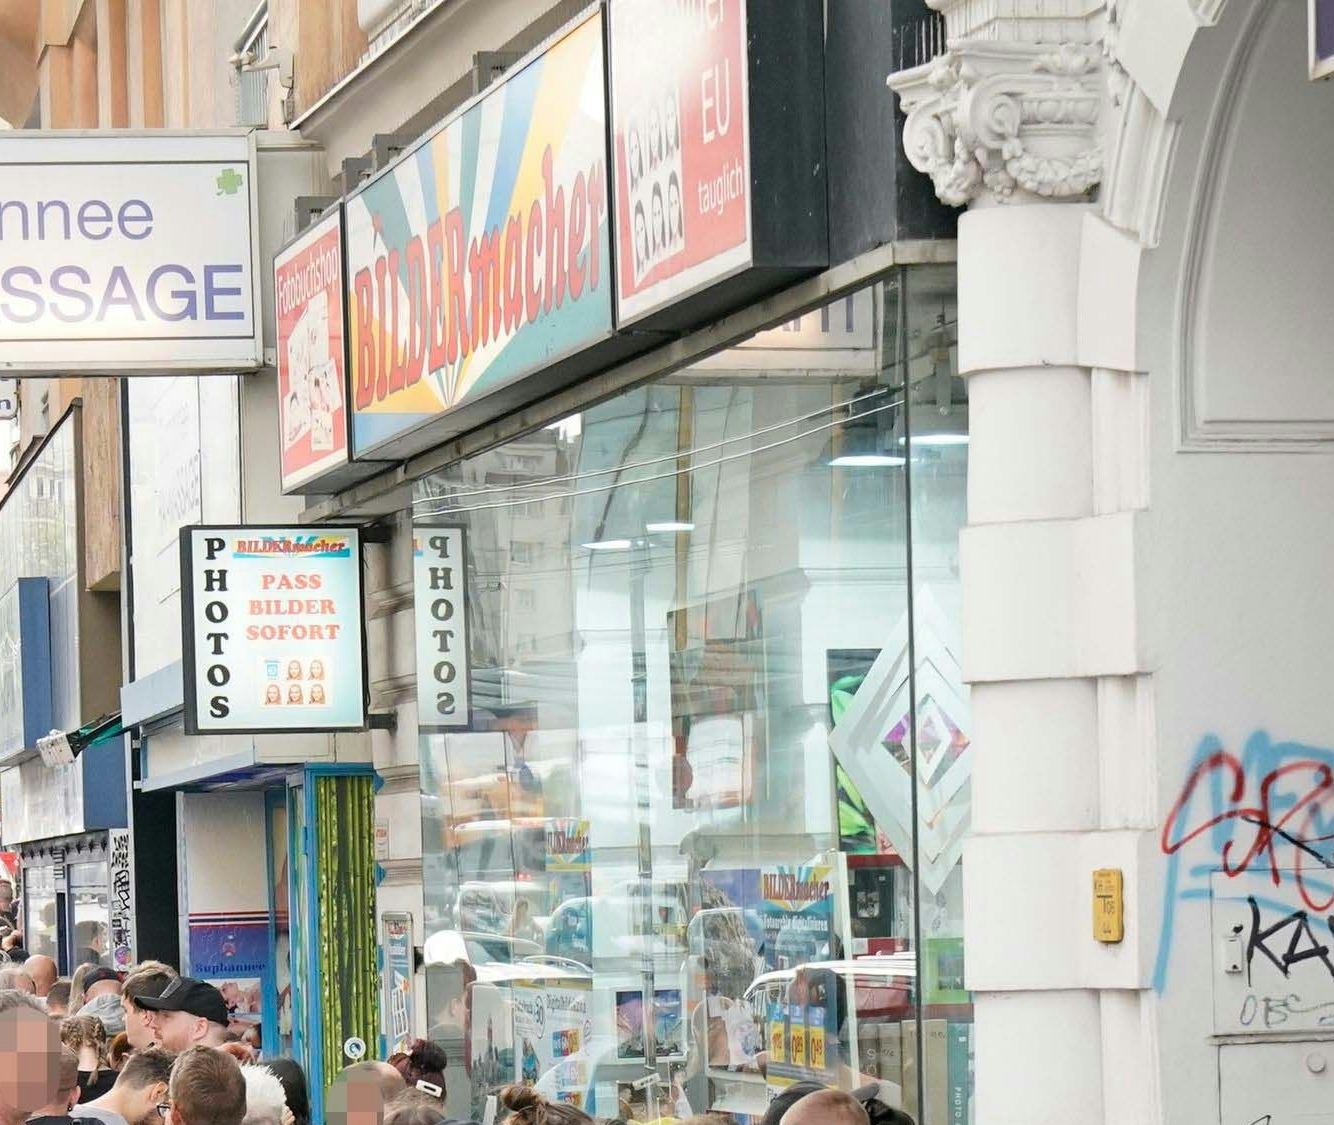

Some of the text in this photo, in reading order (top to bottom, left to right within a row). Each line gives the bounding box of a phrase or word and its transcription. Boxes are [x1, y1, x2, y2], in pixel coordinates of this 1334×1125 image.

[701, 58, 731, 144] EU
[698, 158, 744, 216] tauglich
[277, 246, 339, 318] Fotobuchshop
[352, 145, 606, 410] BILDERmacher
[249, 598, 337, 616] BILDER
[261, 573, 322, 590] PASS
[204, 537, 231, 718] PHOTOS
[245, 622, 340, 641] SOFORT
